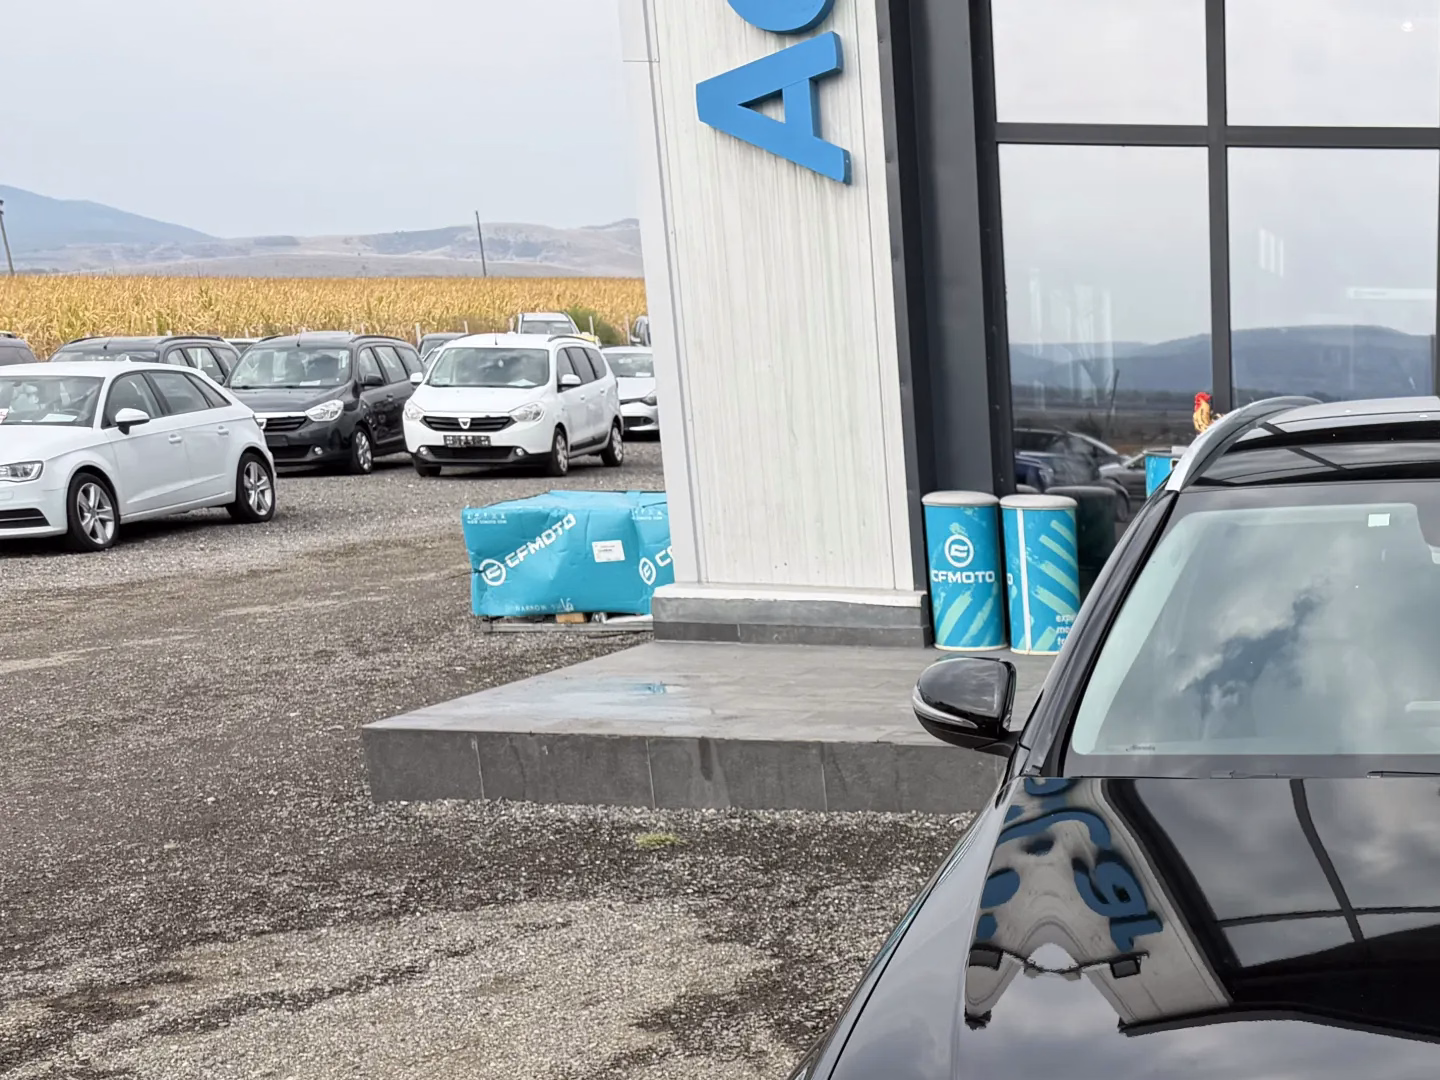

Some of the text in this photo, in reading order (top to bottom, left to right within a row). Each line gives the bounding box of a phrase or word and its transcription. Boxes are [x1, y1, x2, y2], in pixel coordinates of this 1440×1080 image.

[695, 0, 852, 186] A
[505, 513, 577, 568] CFMOTO
[931, 570, 995, 584] CFMOTO
